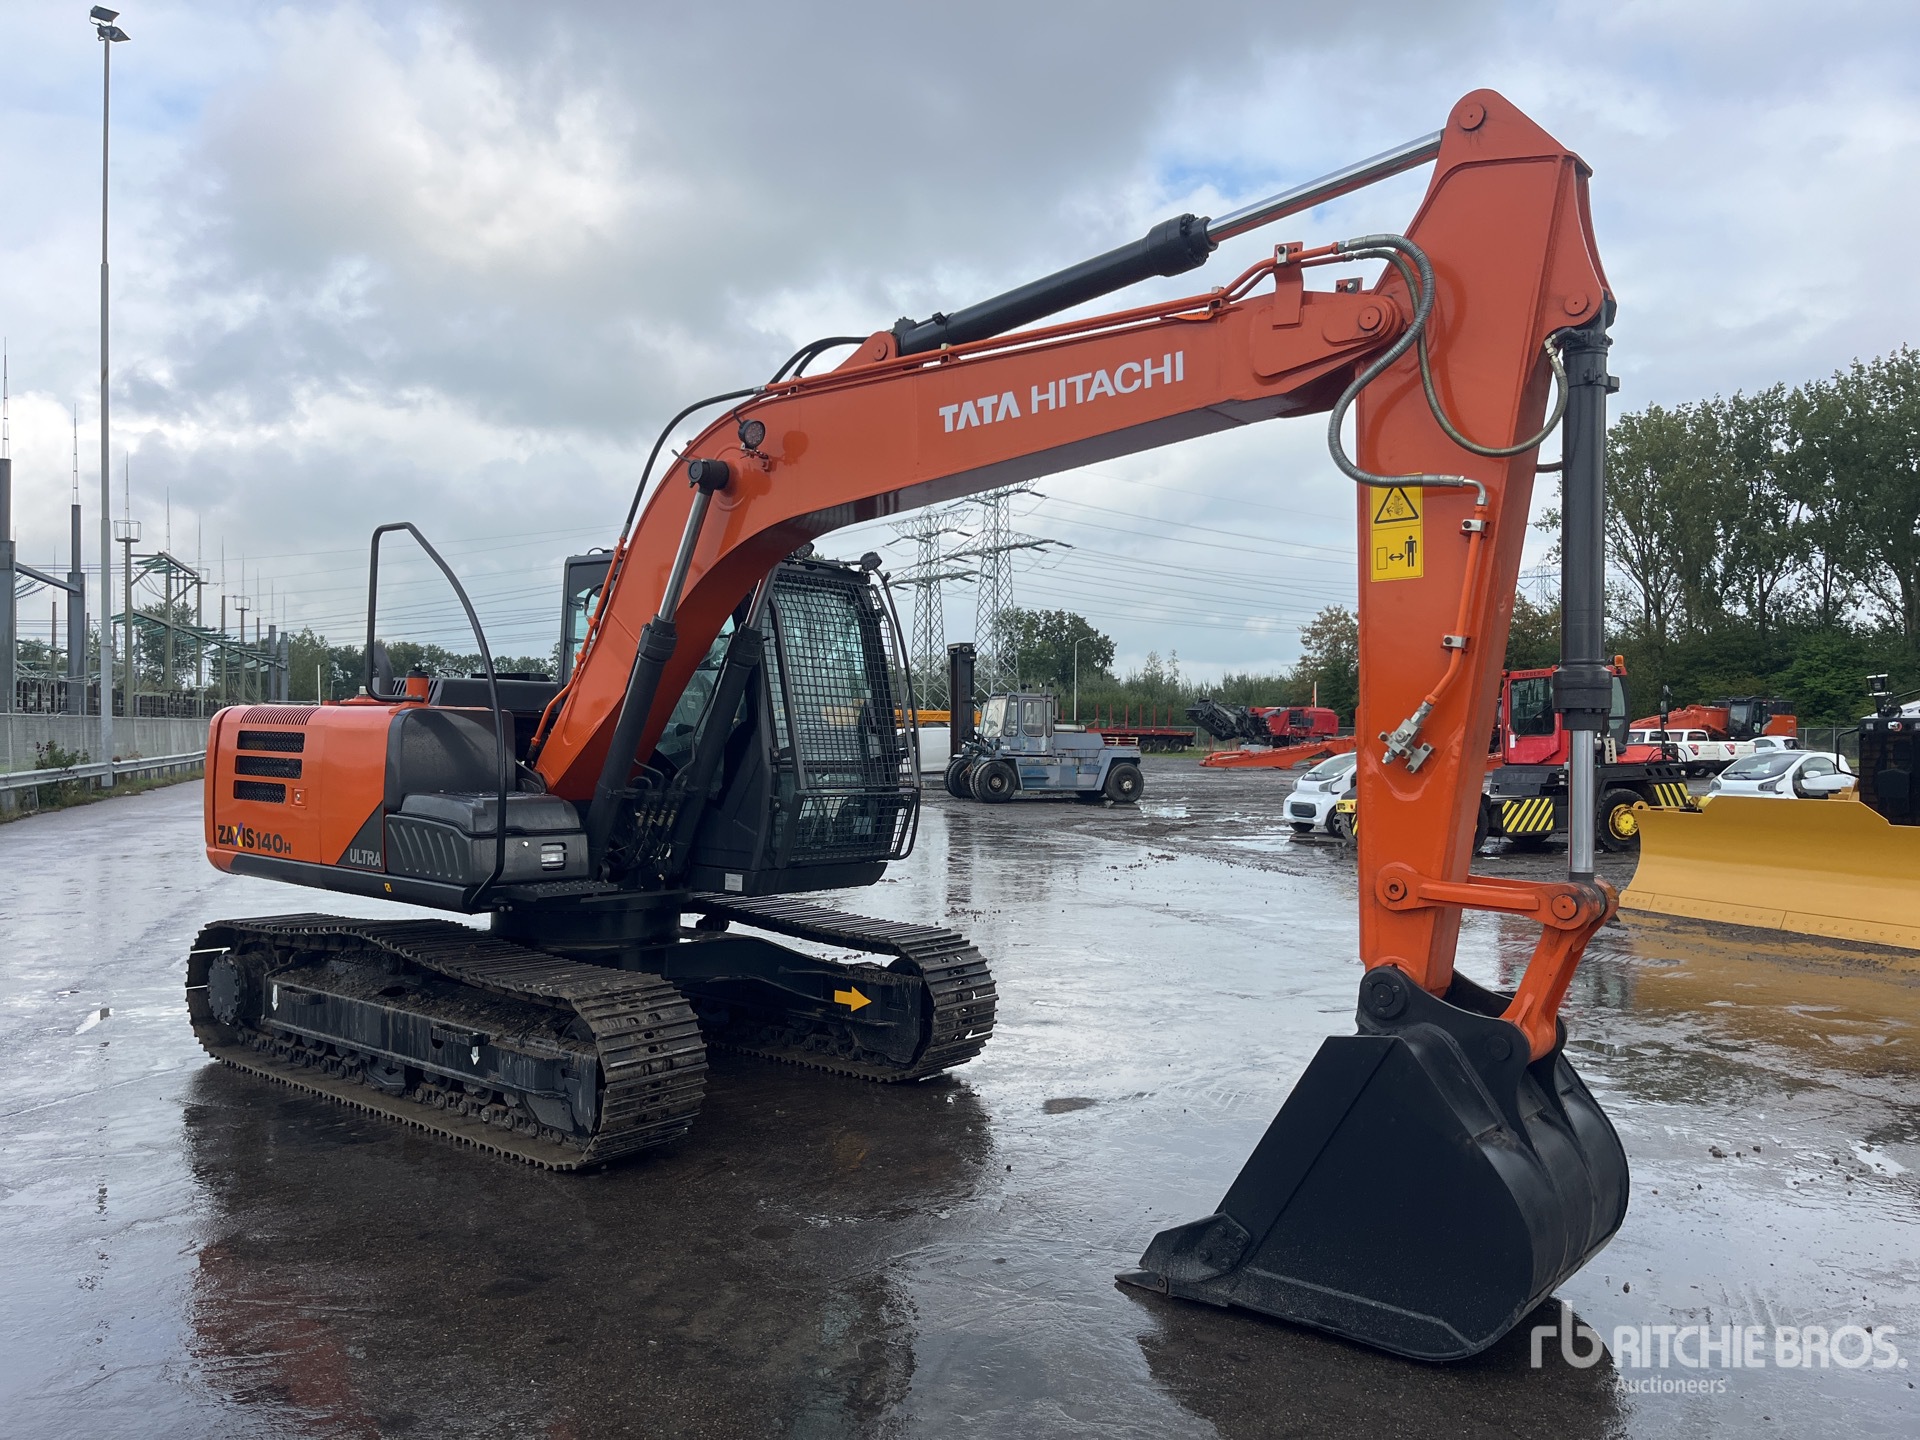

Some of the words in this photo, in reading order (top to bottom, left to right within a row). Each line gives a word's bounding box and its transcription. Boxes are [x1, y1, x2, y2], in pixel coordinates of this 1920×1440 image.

[938, 391, 1021, 433] TATA
[1031, 351, 1184, 414] HITACHI
[1518, 670, 1546, 678] TERBERG
[218, 822, 255, 849] ZAXIS
[350, 848, 382, 867] ULTRA
